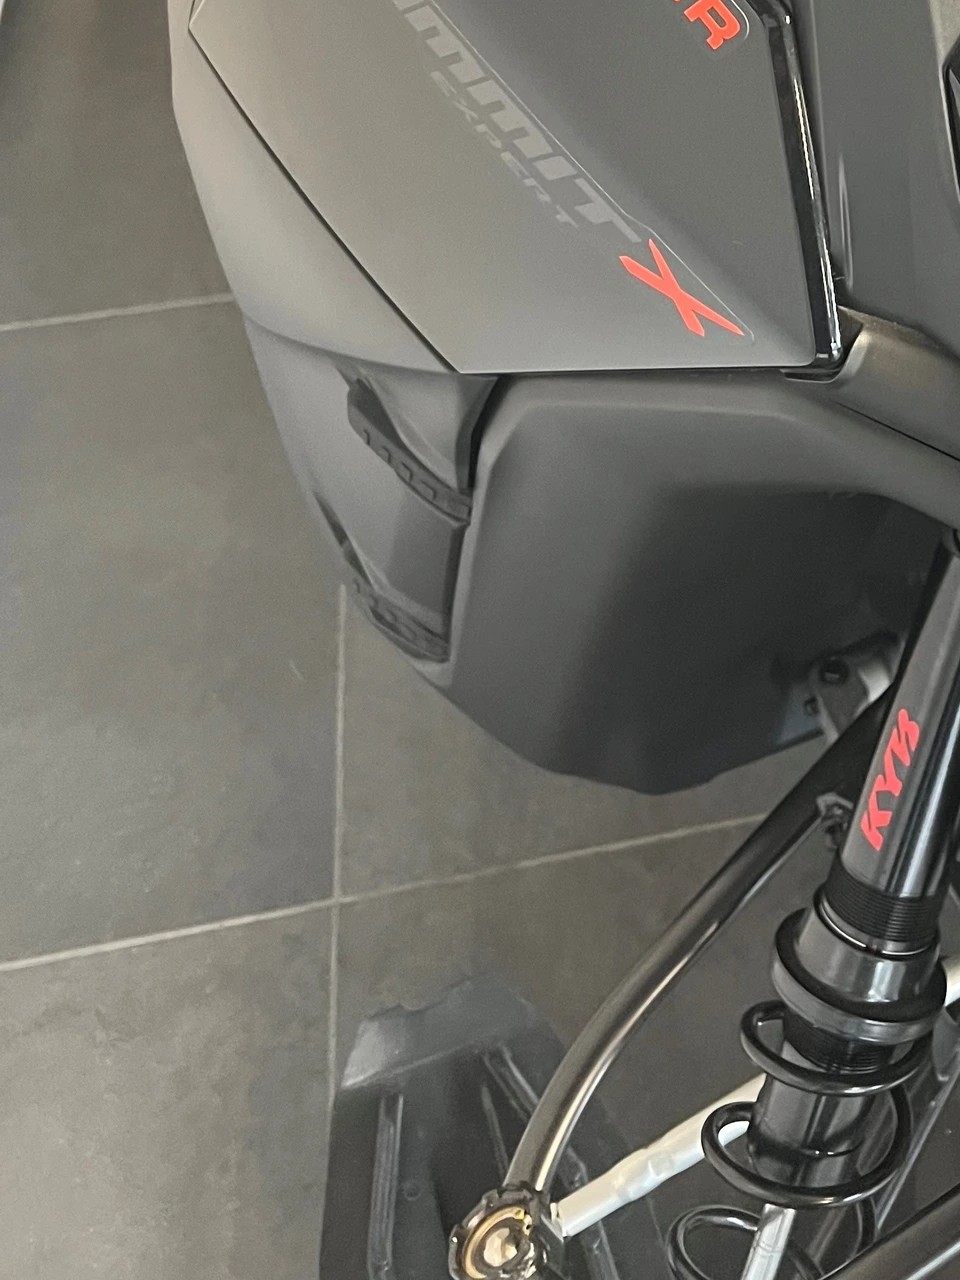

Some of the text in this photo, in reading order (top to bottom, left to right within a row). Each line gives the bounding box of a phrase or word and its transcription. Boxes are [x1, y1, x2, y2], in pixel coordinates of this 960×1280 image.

[430, 71, 580, 227] EXPERT
[619, 238, 745, 336] X
[860, 708, 920, 851] KYB
